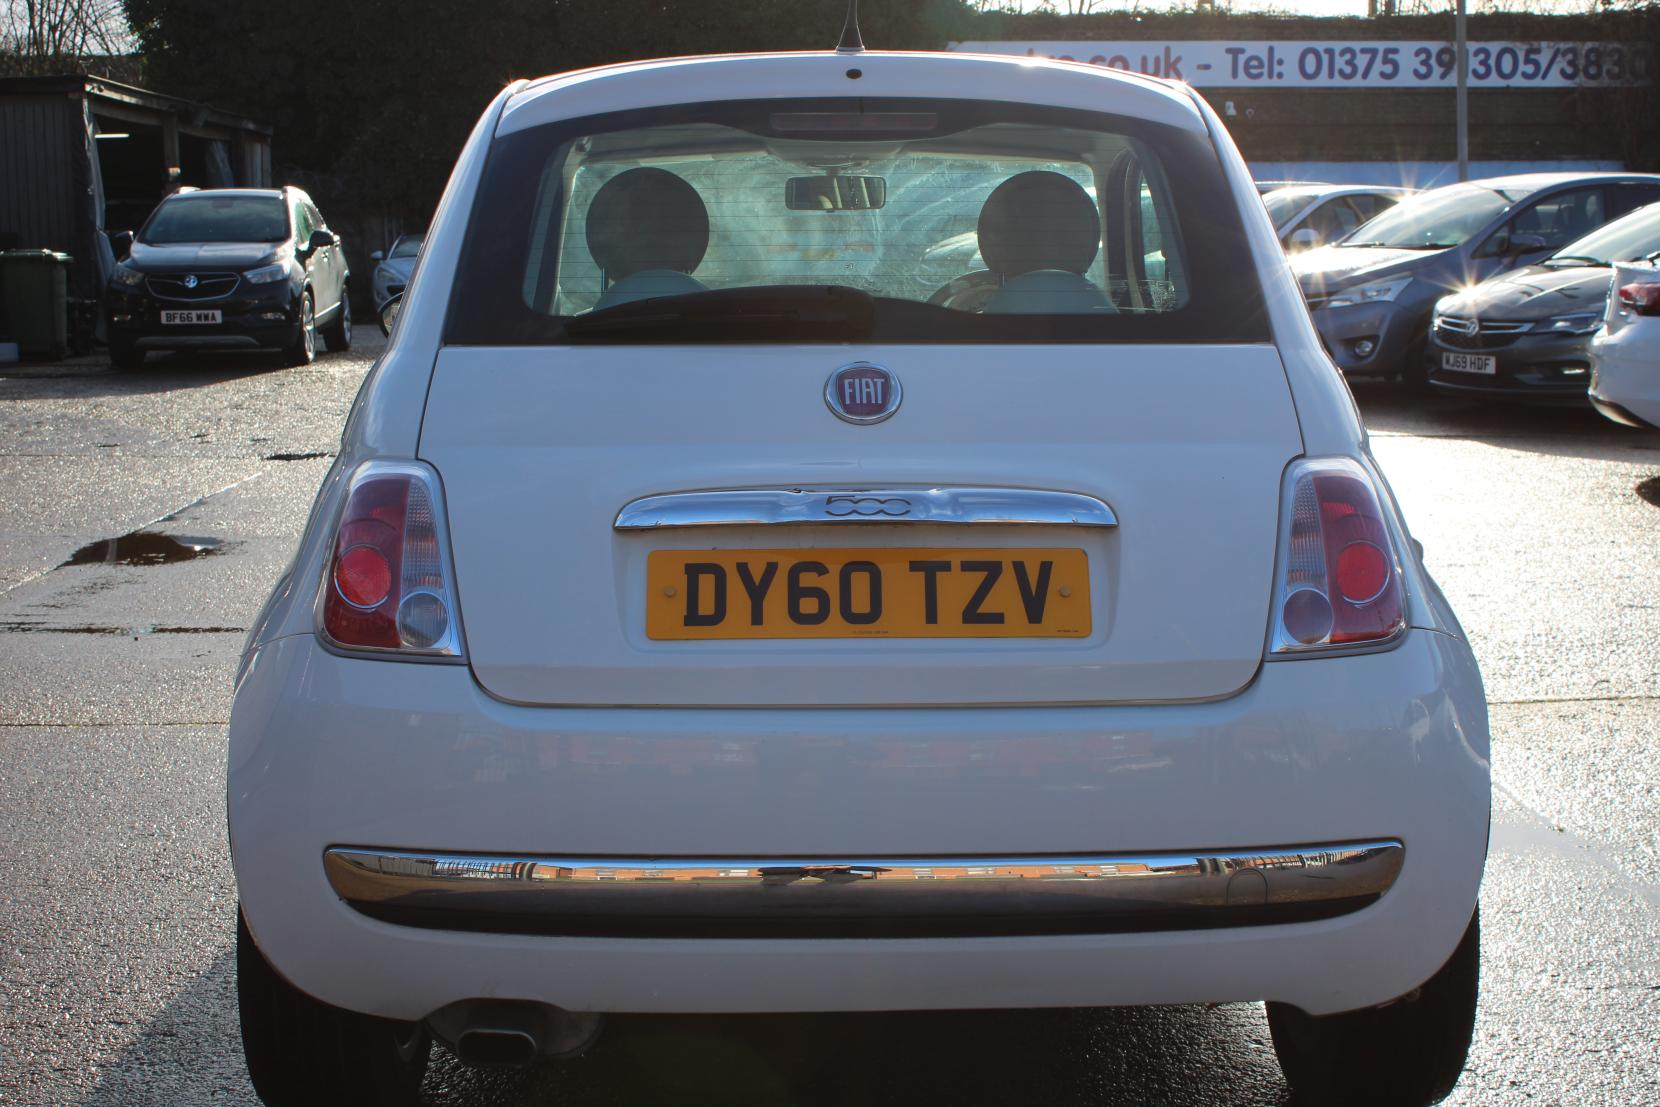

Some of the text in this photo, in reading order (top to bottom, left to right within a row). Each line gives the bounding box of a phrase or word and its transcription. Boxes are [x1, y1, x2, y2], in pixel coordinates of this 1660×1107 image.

[1225, 45, 1284, 80] Tel:
[1298, 46, 1400, 80] 01375
[165, 311, 194, 323] BF66
[1470, 356, 1491, 372] HDF
[843, 378, 885, 405] FIAT
[825, 495, 911, 517] 500
[683, 560, 1054, 627] DY60 TZV
